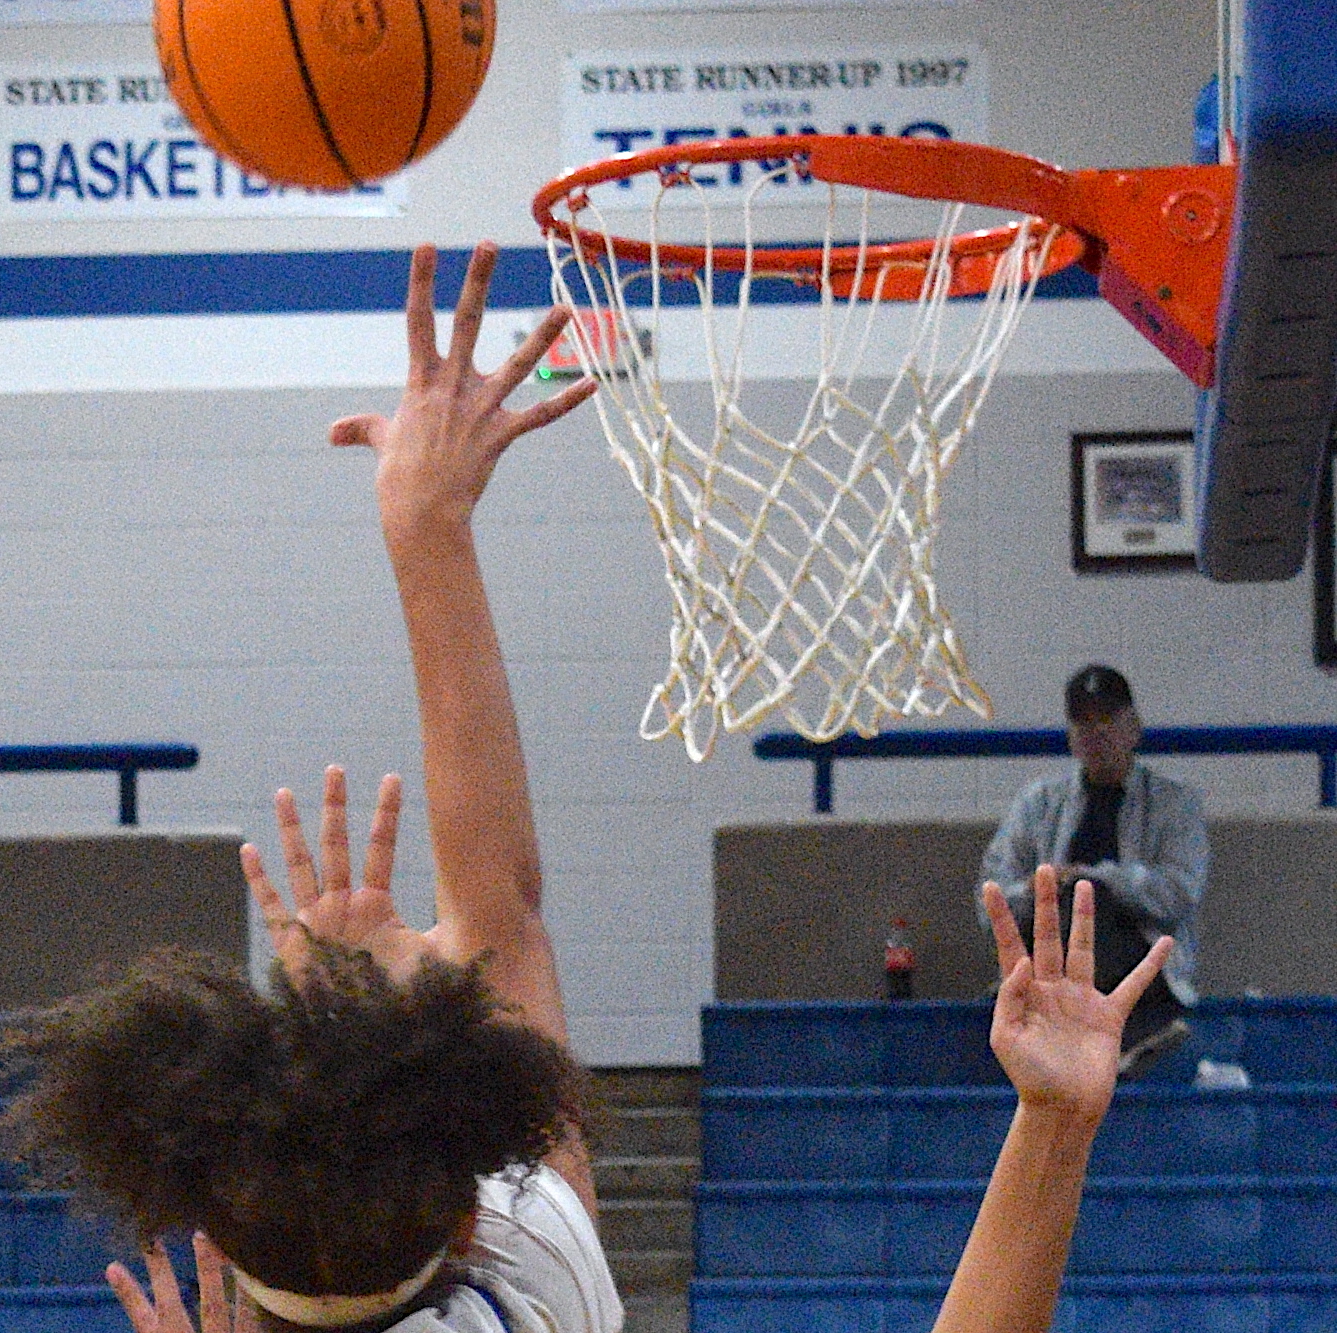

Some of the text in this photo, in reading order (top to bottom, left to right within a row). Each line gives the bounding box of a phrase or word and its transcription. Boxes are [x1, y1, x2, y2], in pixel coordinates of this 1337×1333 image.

[4, 77, 109, 106] STATE
[580, 66, 690, 93] STATE
[896, 58, 969, 88] 1997
